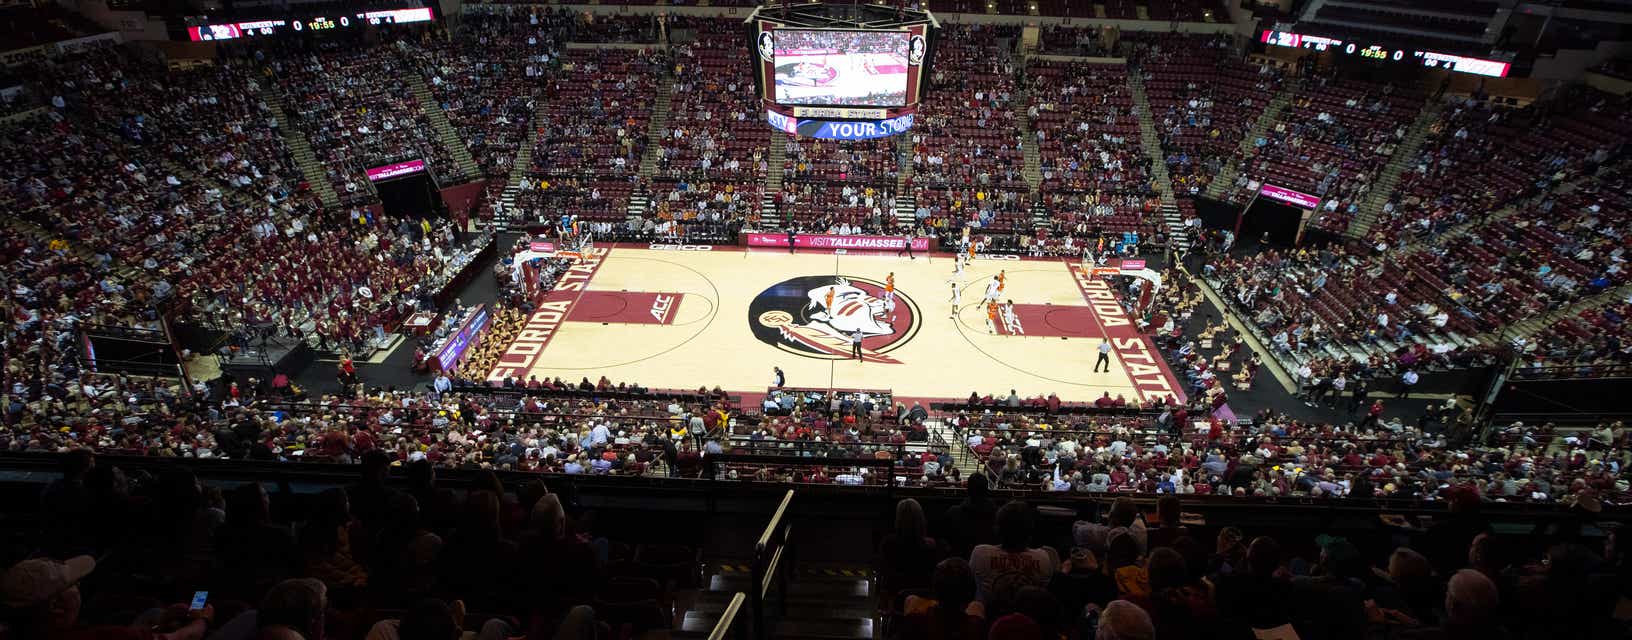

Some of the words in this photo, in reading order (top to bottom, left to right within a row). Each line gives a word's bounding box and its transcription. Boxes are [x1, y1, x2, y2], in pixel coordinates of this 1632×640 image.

[293, 20, 303, 32] 0
[340, 16, 349, 28] 0
[1346, 43, 1356, 55] 0
[1393, 50, 1405, 62] 0
[830, 122, 876, 137] YOUR
[809, 237, 929, 249] VISITTALLAHASSEE.OM
[650, 294, 671, 321] ACC
[487, 299, 573, 382] FLORIDA
[1112, 337, 1185, 405] STATE
